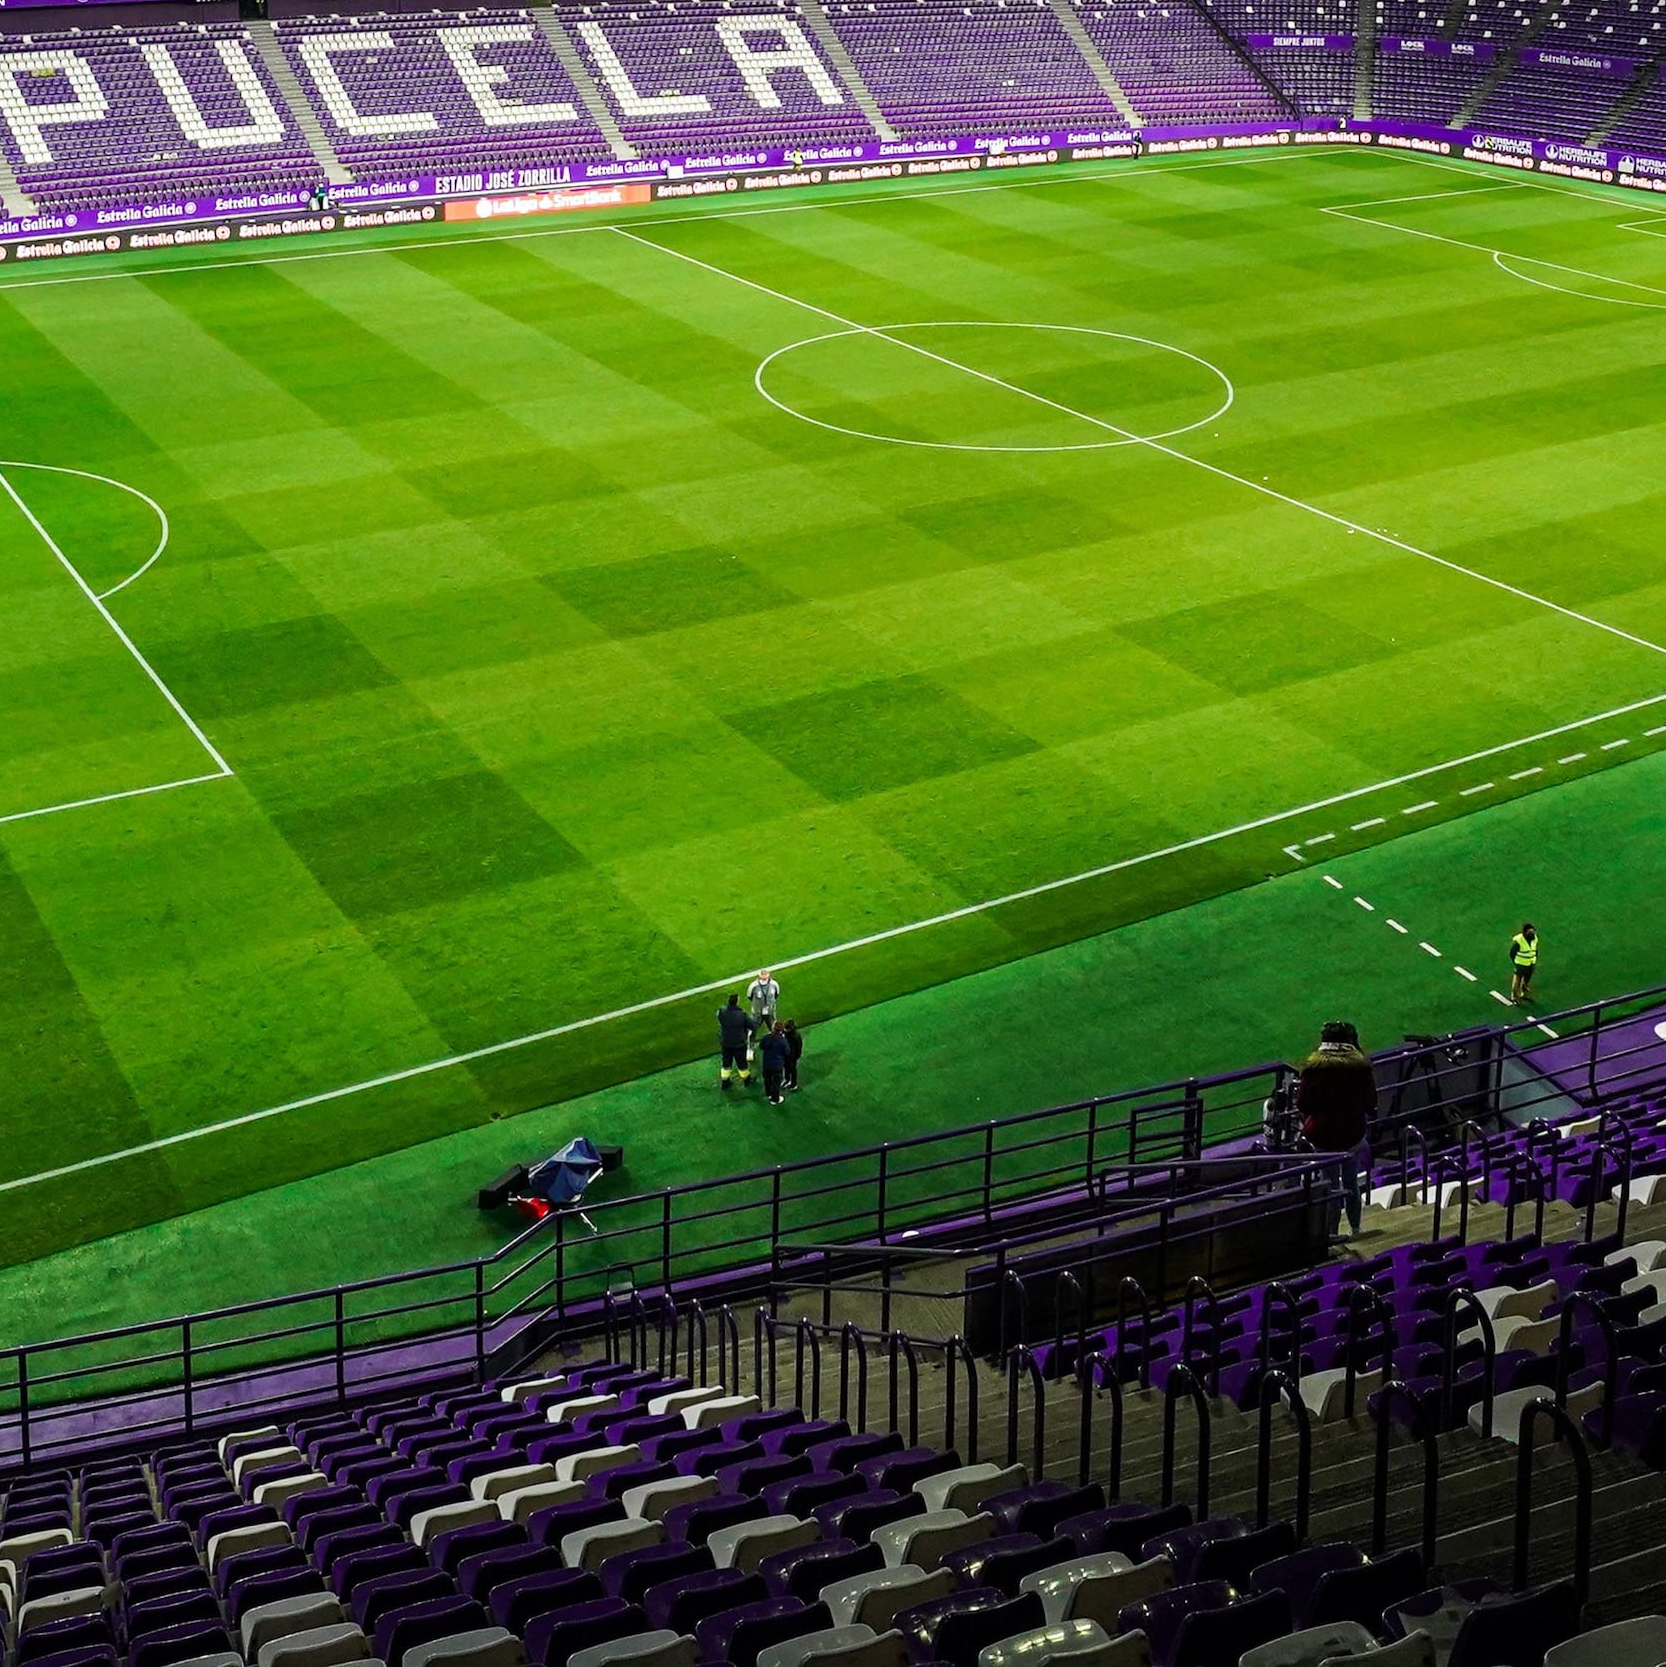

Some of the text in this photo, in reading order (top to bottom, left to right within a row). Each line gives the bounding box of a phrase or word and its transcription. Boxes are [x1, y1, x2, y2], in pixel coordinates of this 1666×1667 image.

[1273, 38, 1299, 46] SIEMPRE
[1539, 52, 1601, 69] Estrella Galicia
[1067, 130, 1132, 144] Estrella Galicia
[879, 142, 947, 156] Estrella Galicia
[586, 161, 659, 178] Estrella Galicia
[685, 153, 755, 169] Estrella Galicia
[435, 166, 571, 194] ESTADIO JOSÉ ZORRILLA
[329, 180, 407, 199] Estrella Galicia
[215, 191, 298, 212] Estrella Galicia
[97, 203, 184, 224] Estrella Galicia
[21, 215, 63, 232] Galicia
[239, 218, 321, 238] Estrella Galicia
[130, 228, 215, 249] Estrella Galicia
[17, 237, 105, 260] Estrella Galicia
